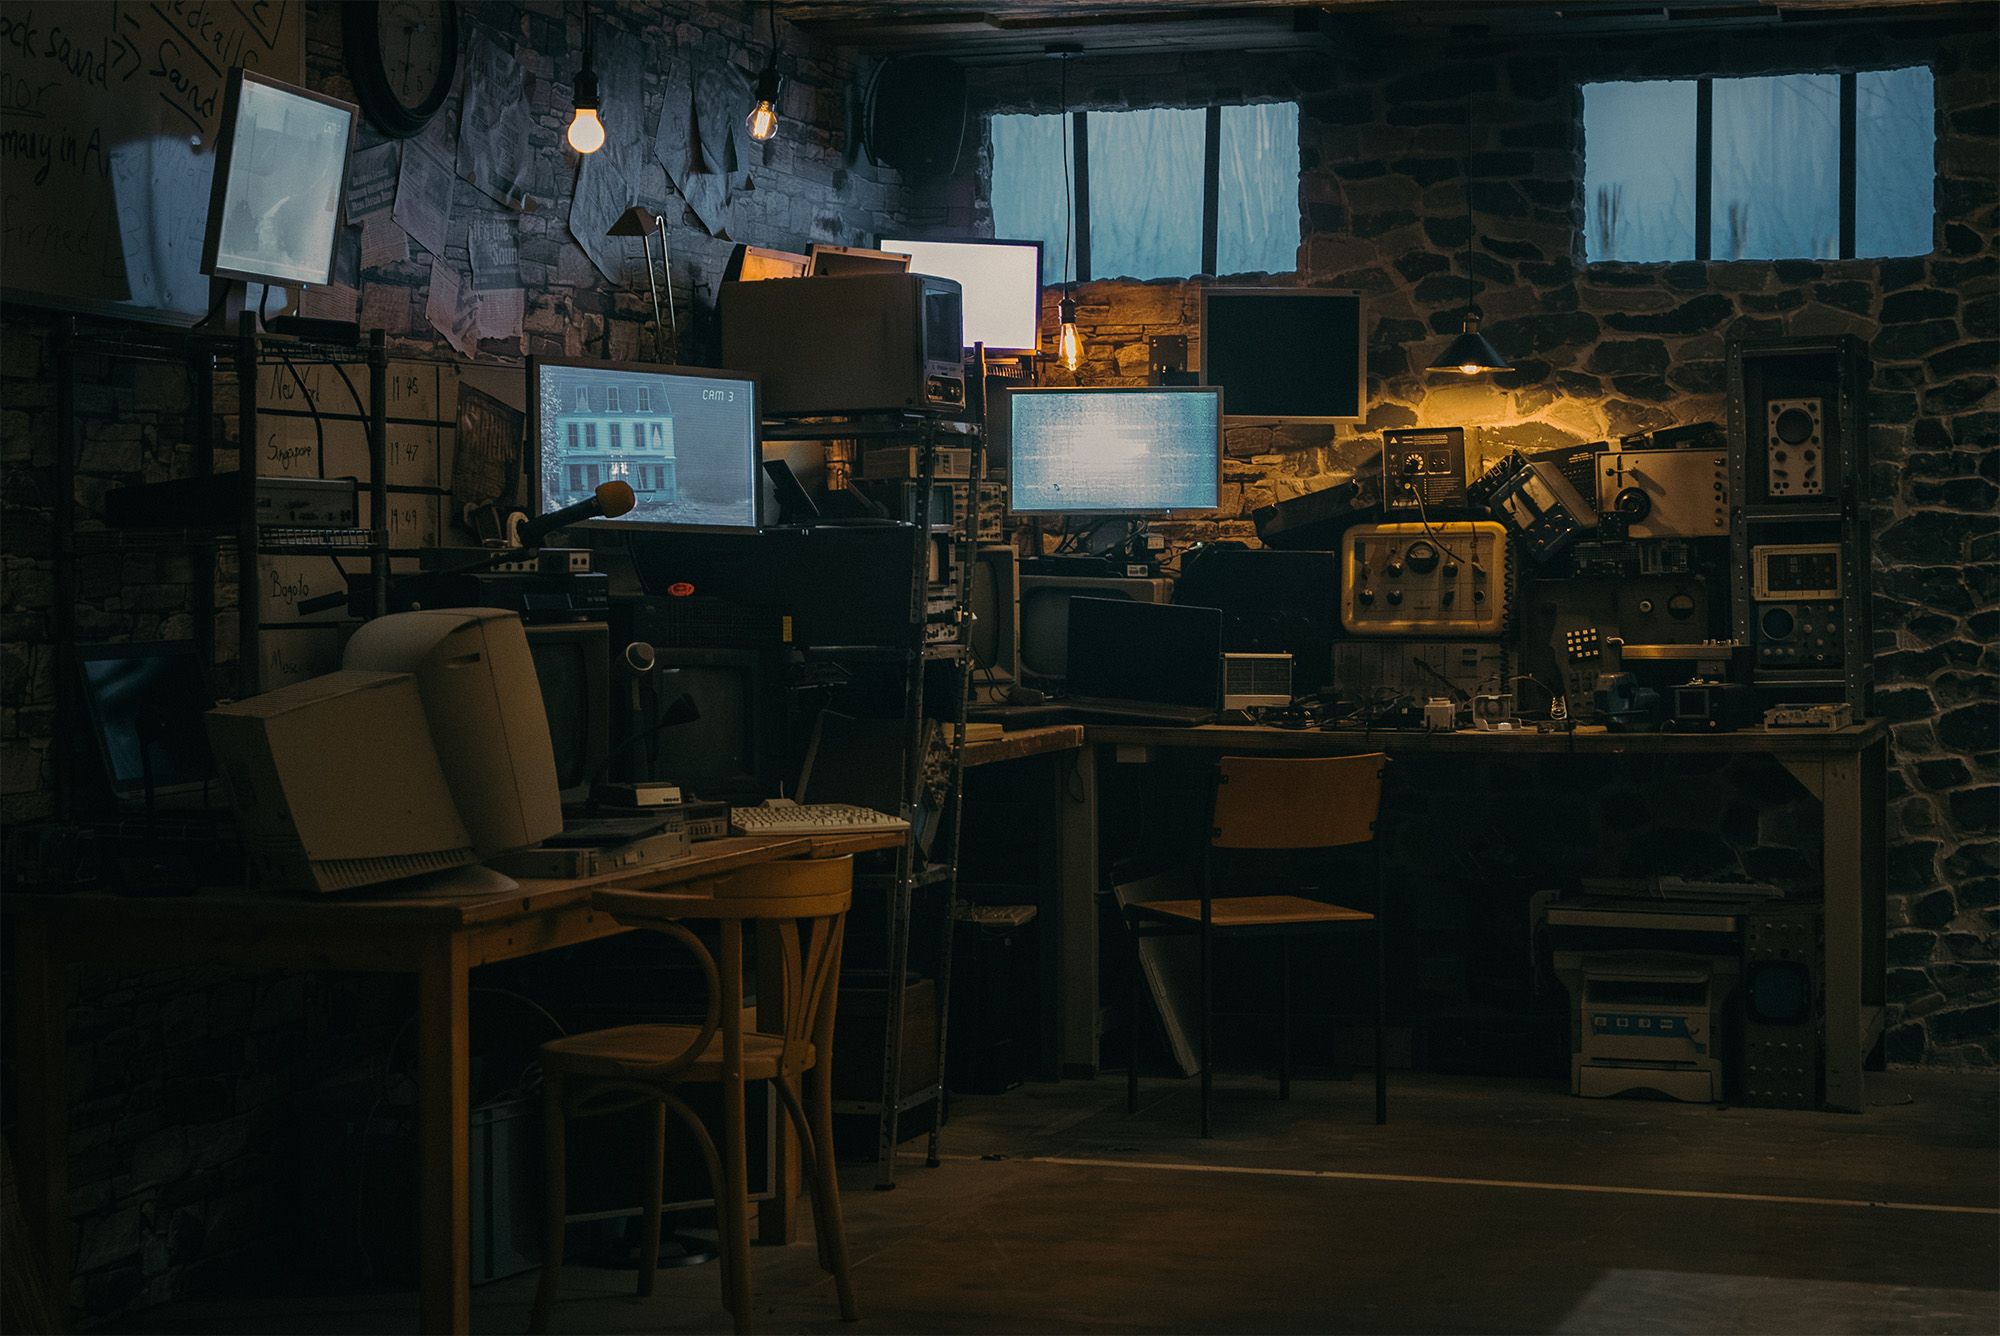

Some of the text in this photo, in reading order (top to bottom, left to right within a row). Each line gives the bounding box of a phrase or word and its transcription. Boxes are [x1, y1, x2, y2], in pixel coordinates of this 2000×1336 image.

[301, 366, 320, 402] Yrk
[702, 389, 734, 402] CAM 3
